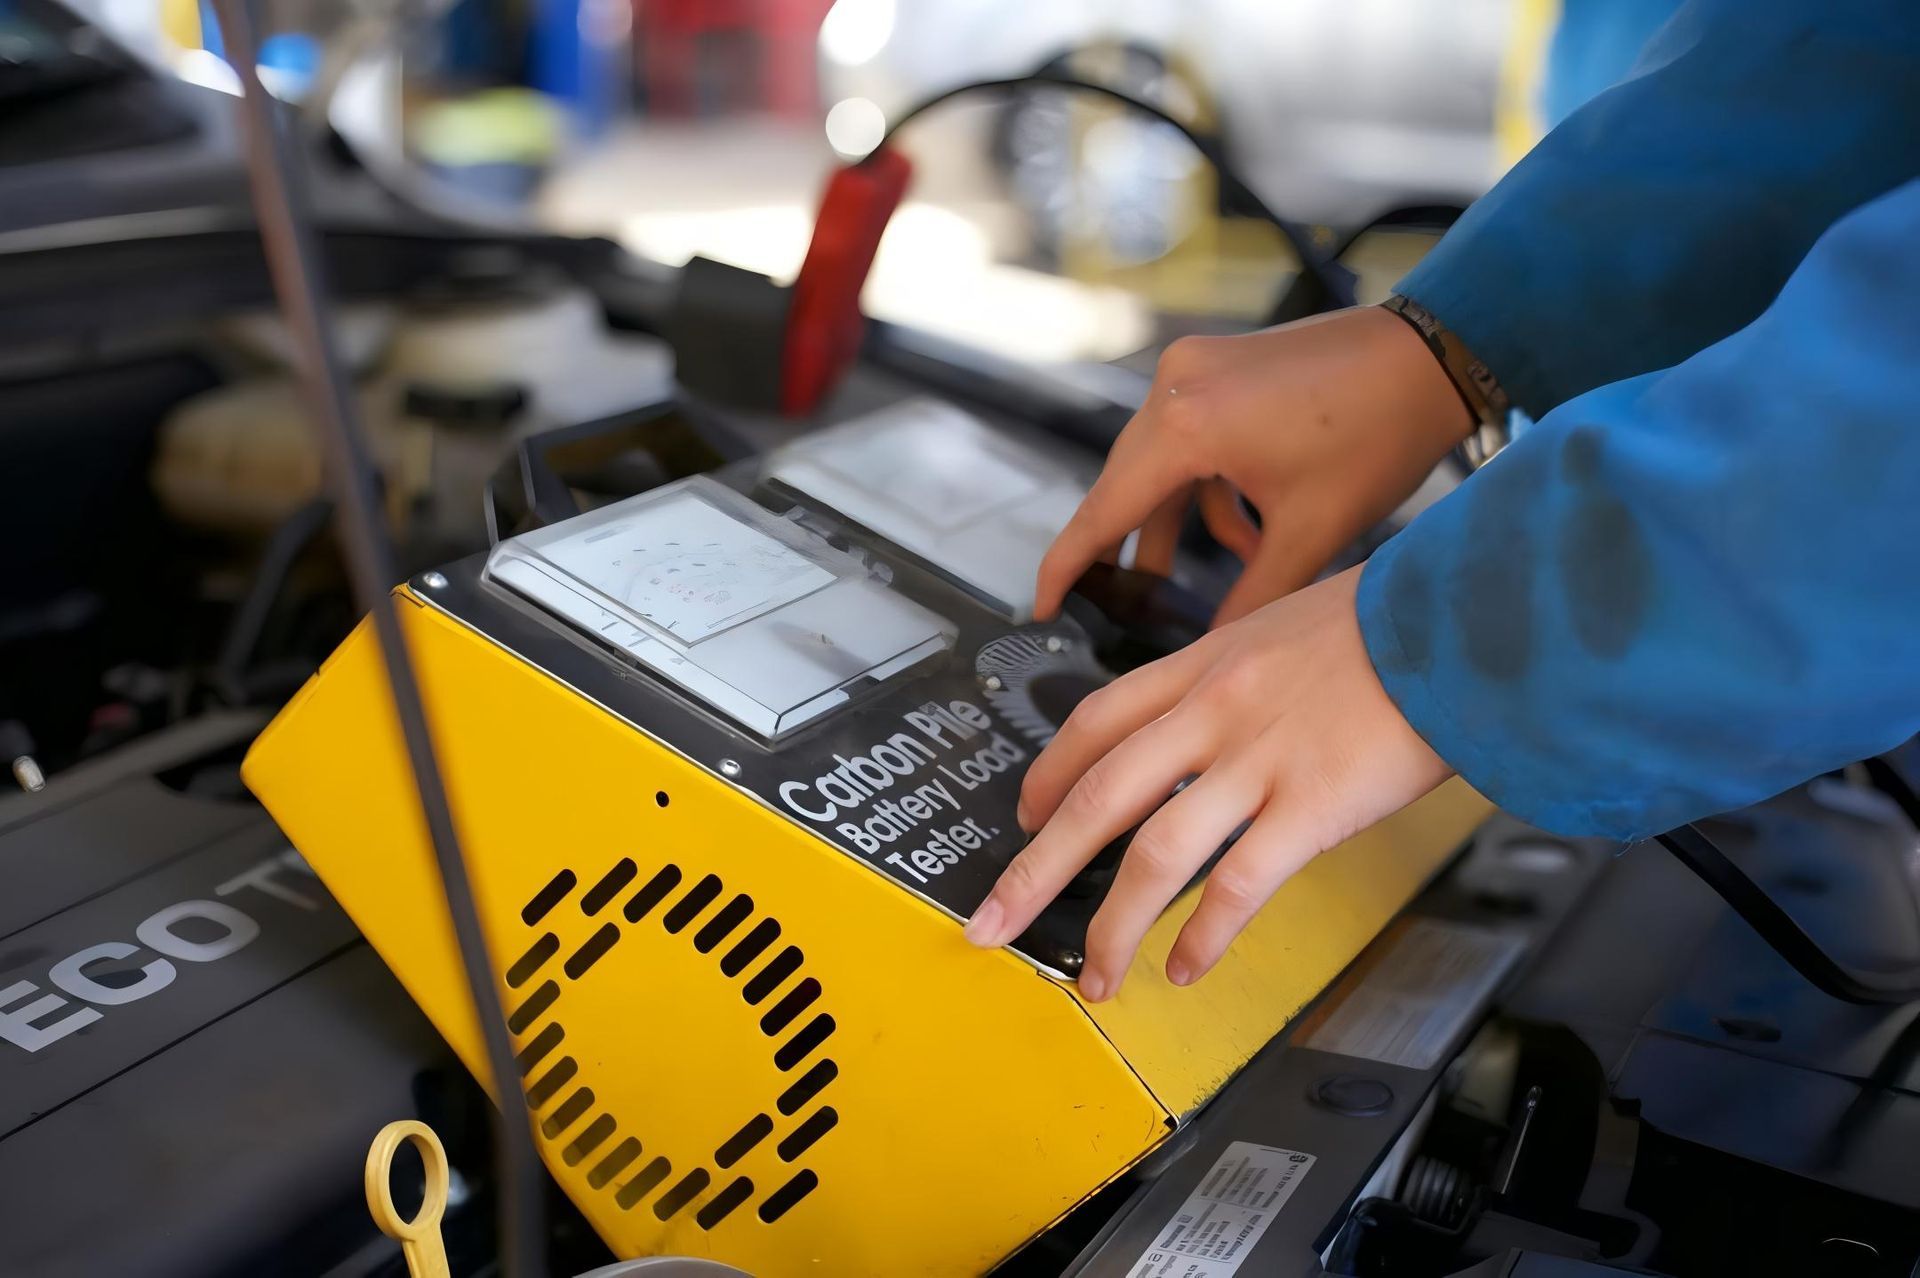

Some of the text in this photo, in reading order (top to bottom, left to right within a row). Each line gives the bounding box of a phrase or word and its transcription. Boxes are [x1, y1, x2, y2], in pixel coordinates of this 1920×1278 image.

[778, 700, 991, 821] Carbon Pile
[835, 731, 1025, 854] Battery Load
[0, 850, 319, 1053] ECOT
